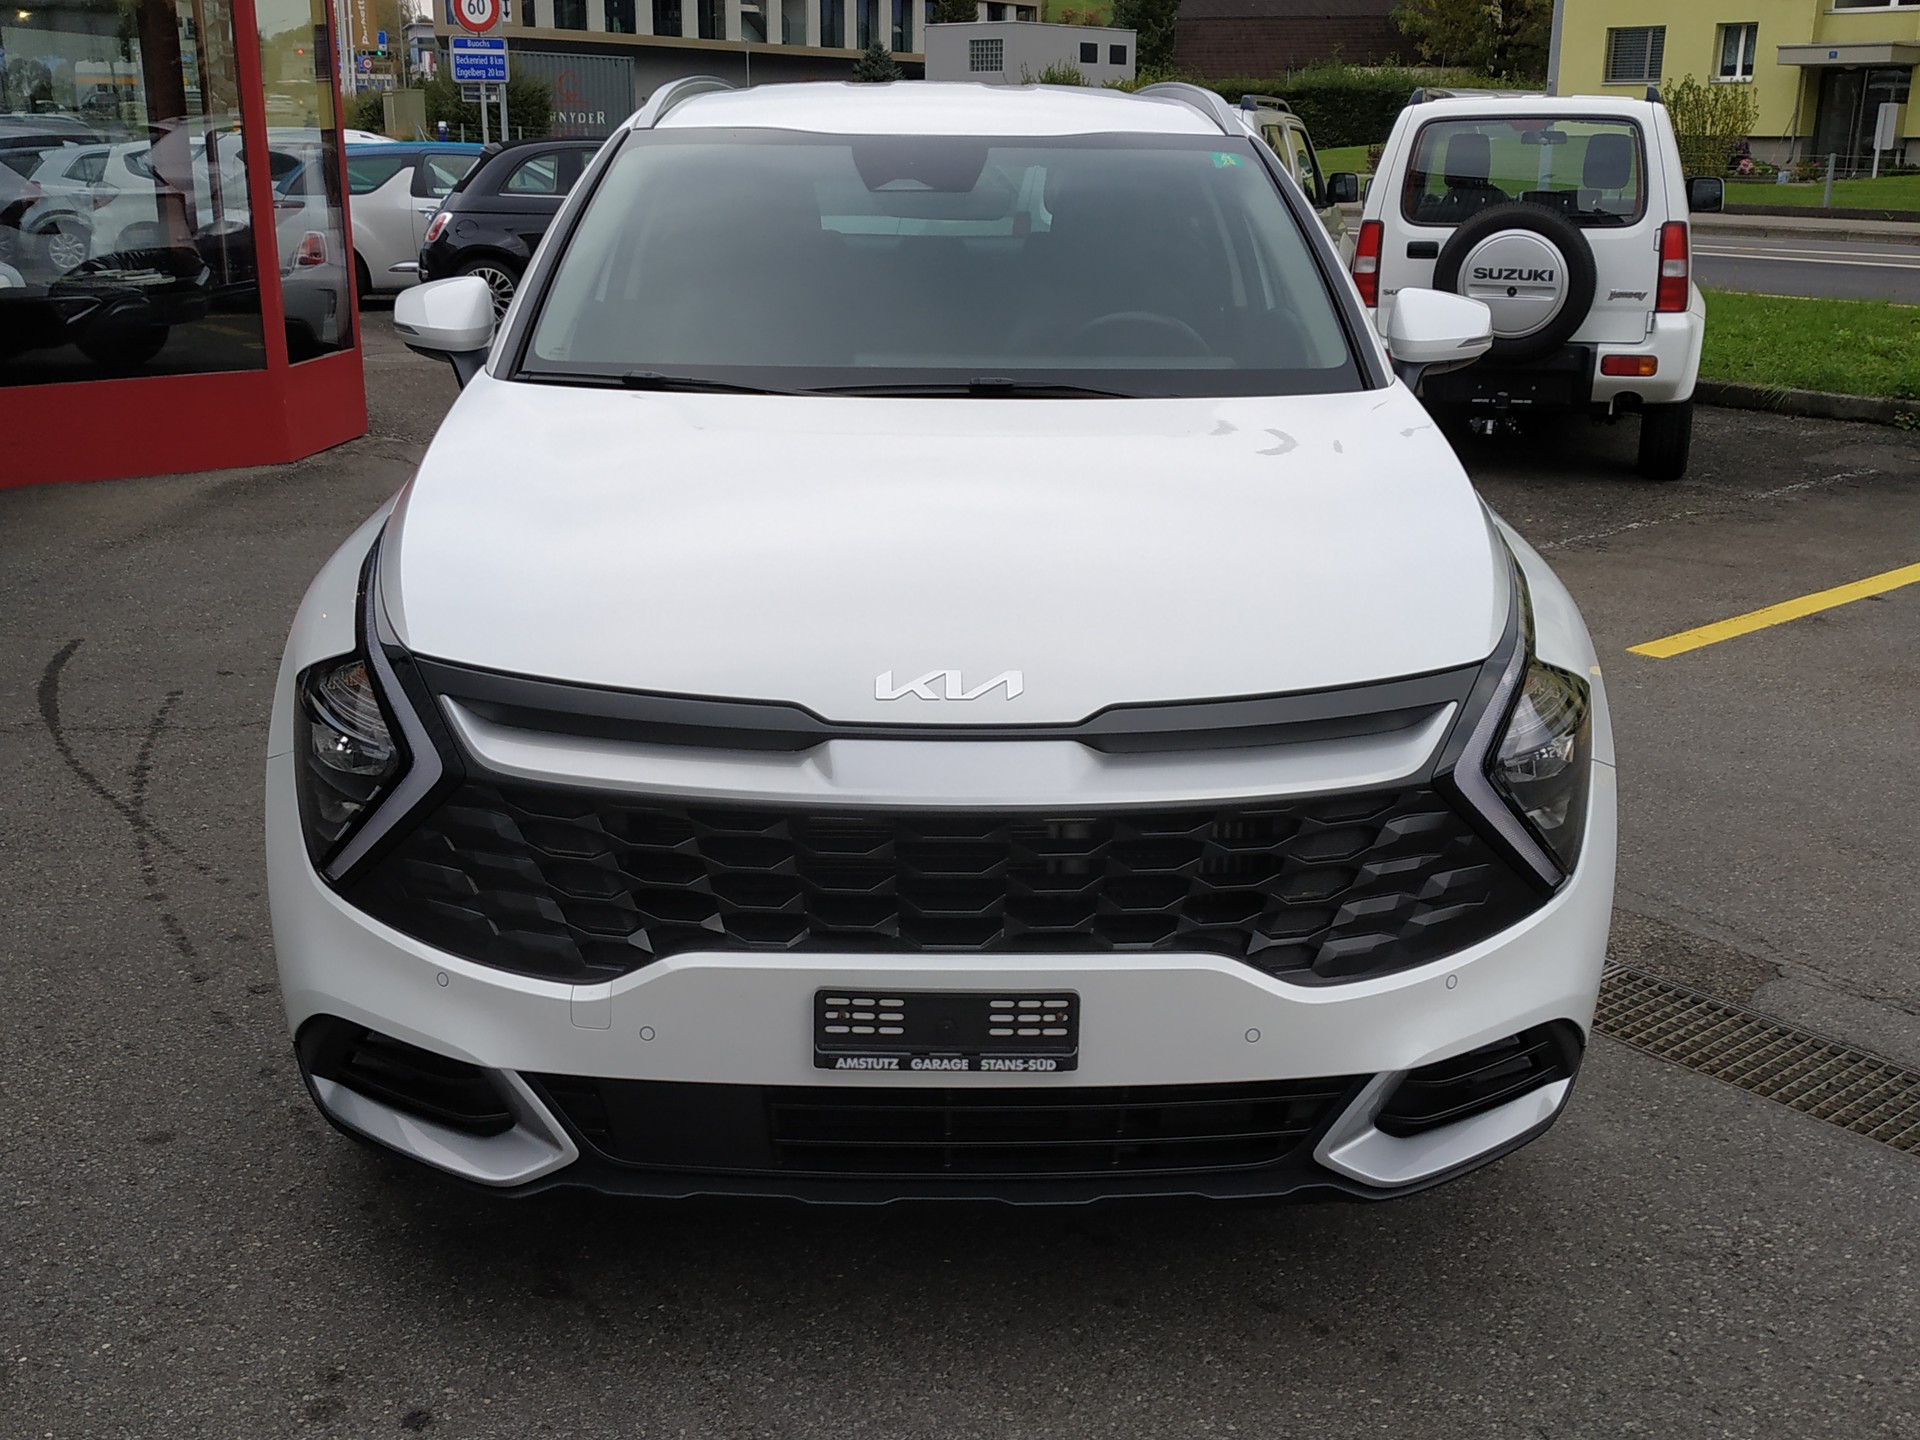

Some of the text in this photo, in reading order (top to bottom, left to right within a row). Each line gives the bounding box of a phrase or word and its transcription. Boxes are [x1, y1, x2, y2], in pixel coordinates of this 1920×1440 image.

[467, 0, 486, 15] 60
[467, 39, 490, 48] Buochs
[455, 55, 504, 65] Beckenried 8 km
[456, 67, 505, 79] Engelberg 20 km
[549, 110, 606, 125] HNYDER
[1473, 267, 1554, 282] SUZUKI
[875, 669, 1024, 701] KIA
[835, 1057, 1057, 1072] AMSTUTZ GARAGE STANS-SÜD
